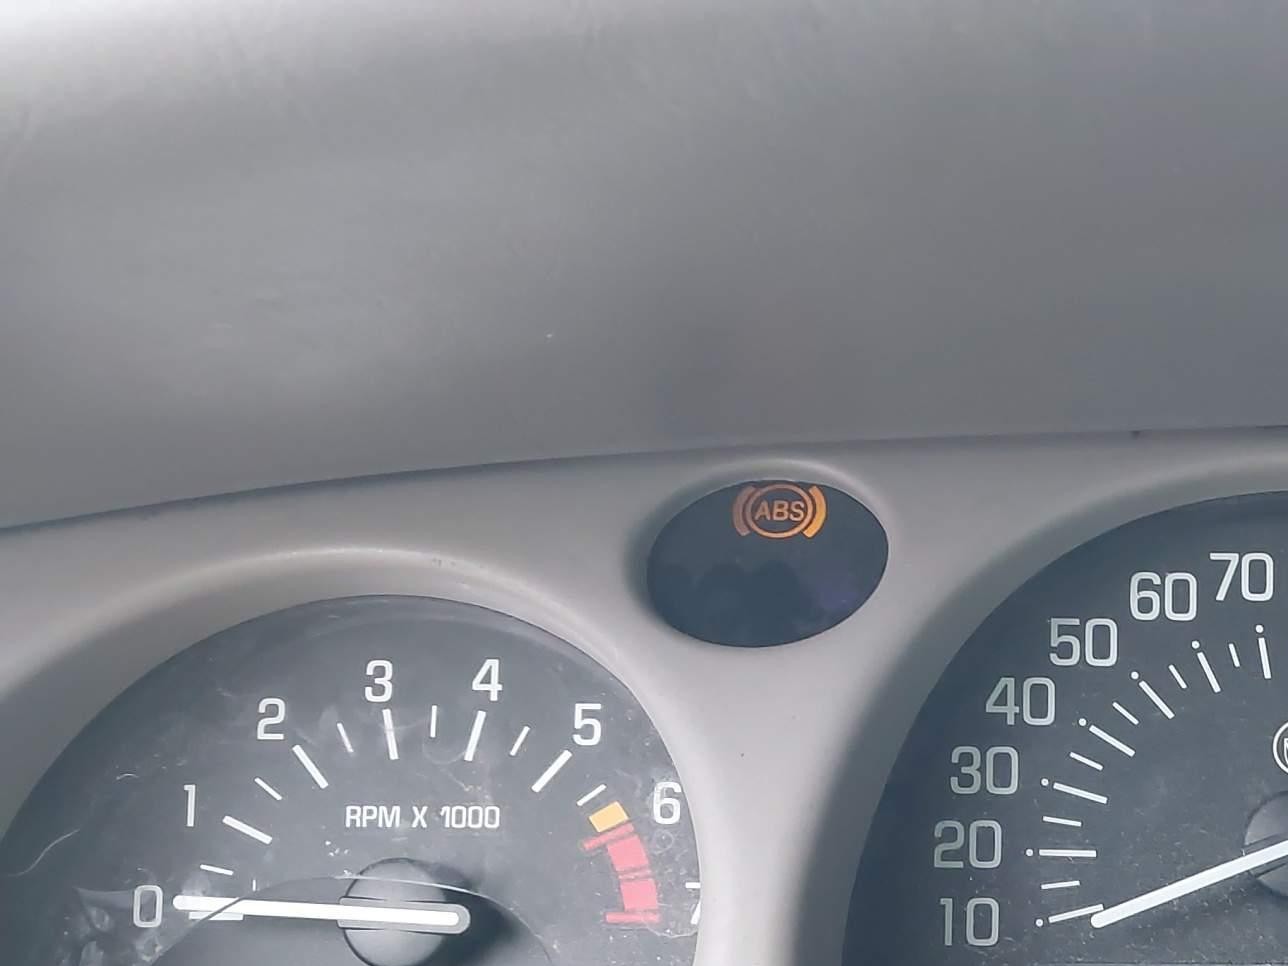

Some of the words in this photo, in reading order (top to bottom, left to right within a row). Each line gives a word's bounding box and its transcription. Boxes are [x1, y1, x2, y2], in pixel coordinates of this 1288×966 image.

[754, 499, 806, 523] ABS
[1129, 571, 1198, 622] 60
[1209, 552, 1274, 602] 70
[1049, 617, 1118, 667] 50
[364, 659, 393, 703] 3
[471, 658, 503, 702] 4
[985, 677, 1056, 726] 40
[256, 697, 286, 740] 2
[572, 703, 602, 746] 5
[950, 746, 1019, 795] 30
[183, 784, 196, 827] 1
[345, 805, 401, 829] RPM
[411, 805, 429, 829] X
[439, 805, 501, 829] 1000
[652, 779, 682, 825] 6
[934, 819, 1003, 869] 20
[133, 884, 164, 928] 0
[940, 897, 1000, 947] 10
